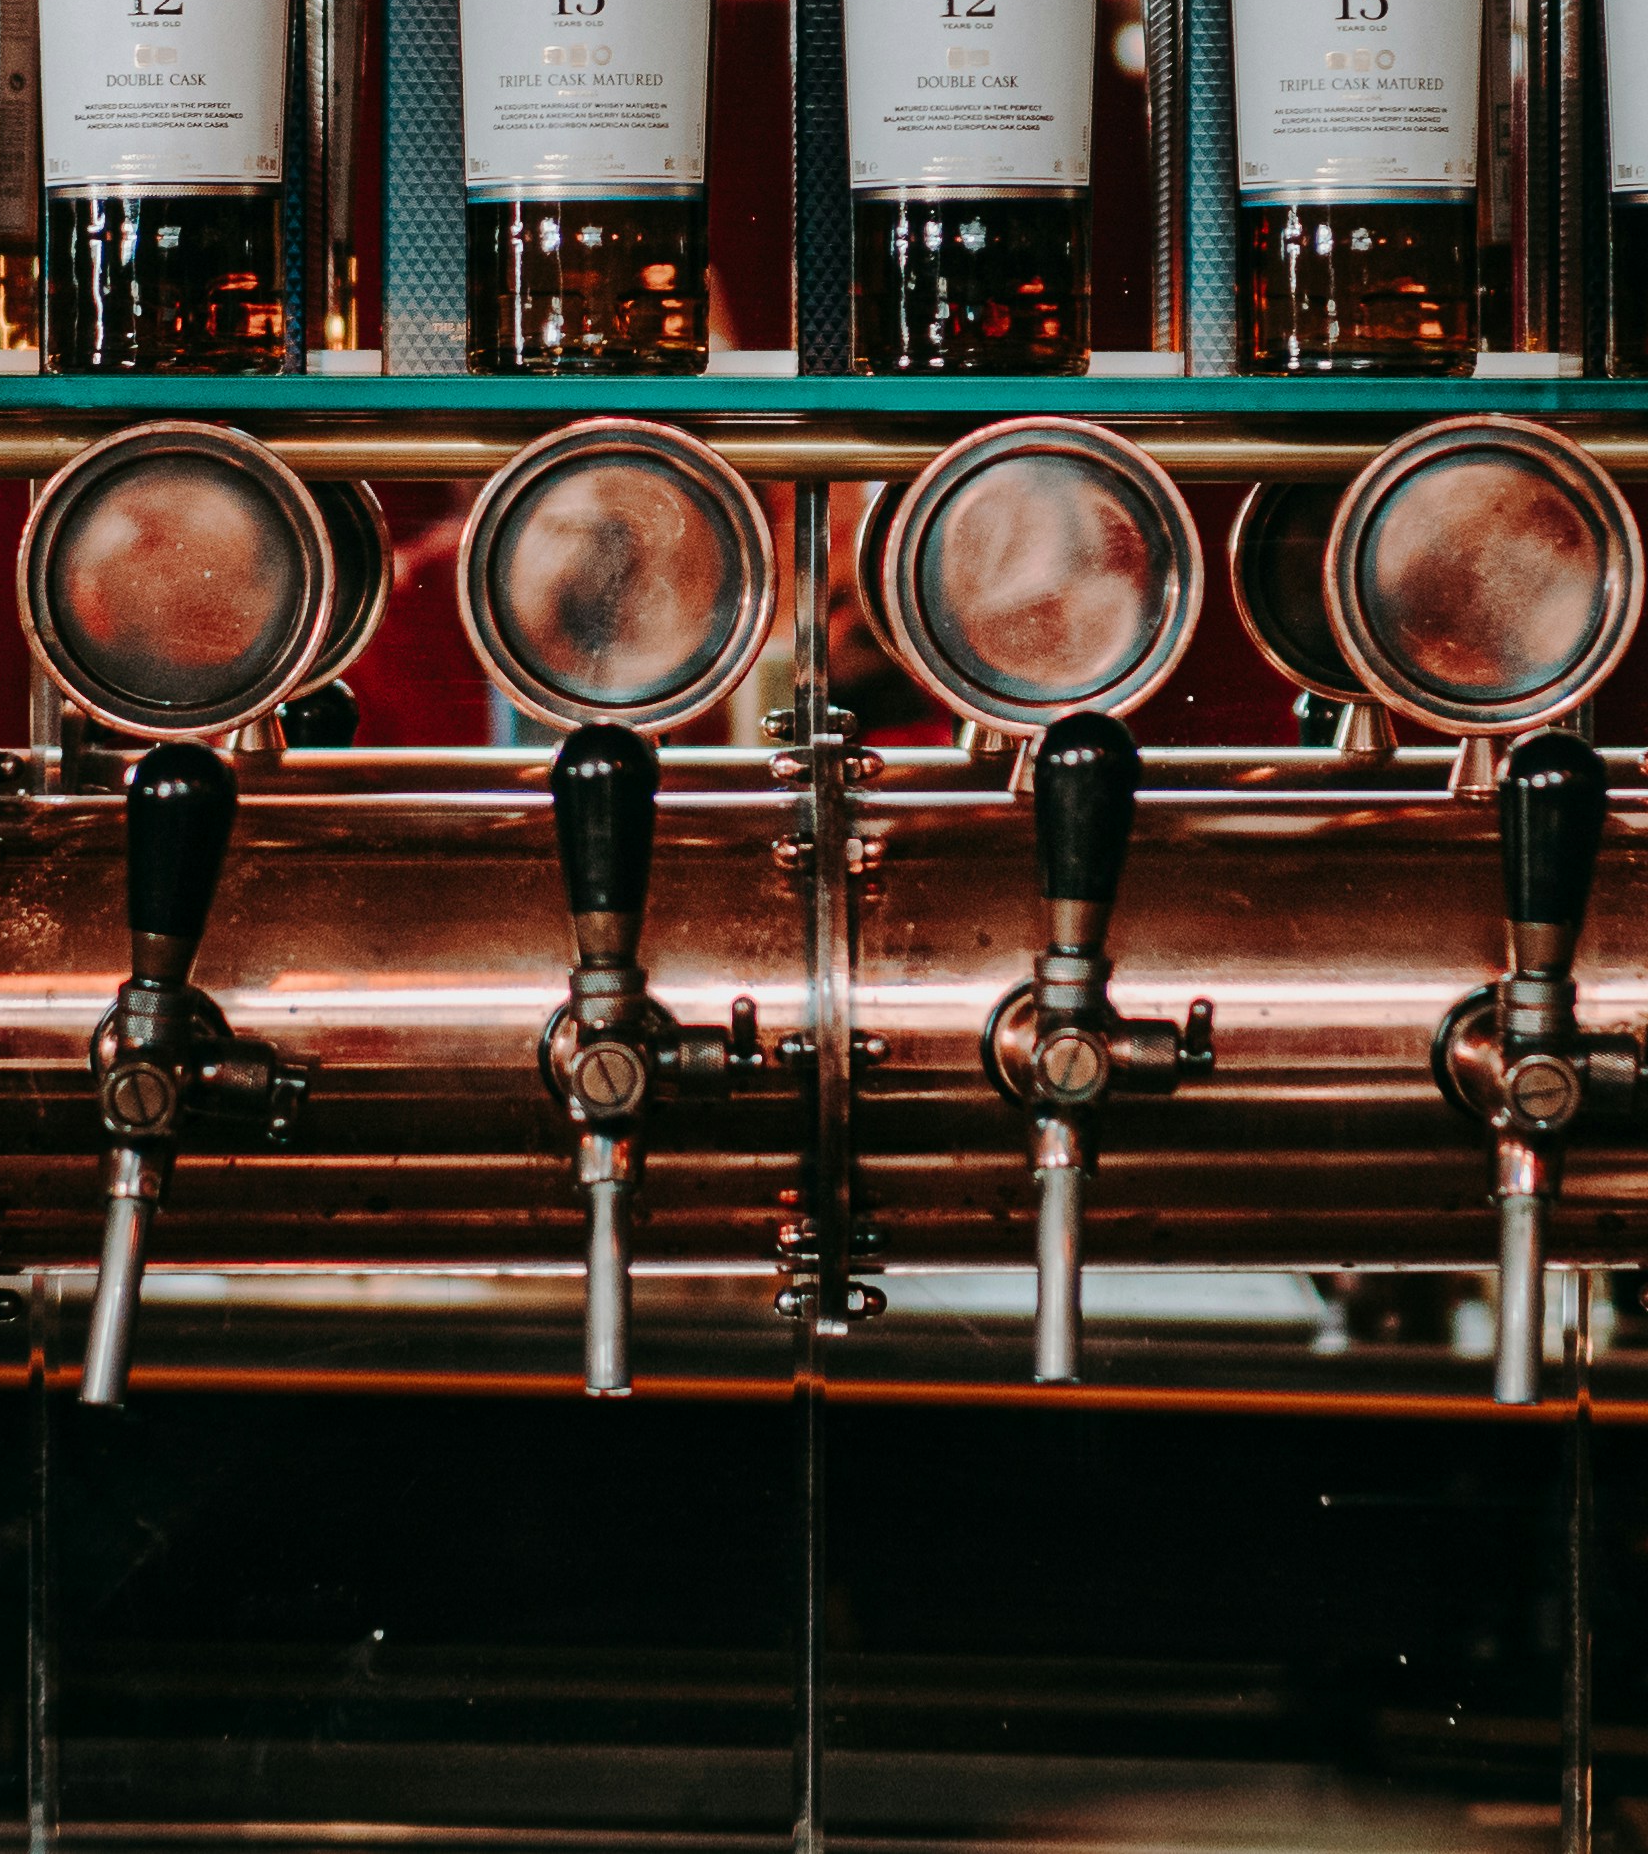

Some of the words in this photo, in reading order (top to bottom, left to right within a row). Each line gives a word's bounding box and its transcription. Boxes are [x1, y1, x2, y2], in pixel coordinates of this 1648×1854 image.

[106, 74, 164, 87] DOUBLE
[169, 73, 206, 85] CASK
[500, 75, 541, 87] TRIPLE
[548, 74, 586, 86] CASK
[592, 73, 663, 86] MATURED
[917, 76, 975, 88] DOUBLE
[982, 75, 1018, 87] CASK
